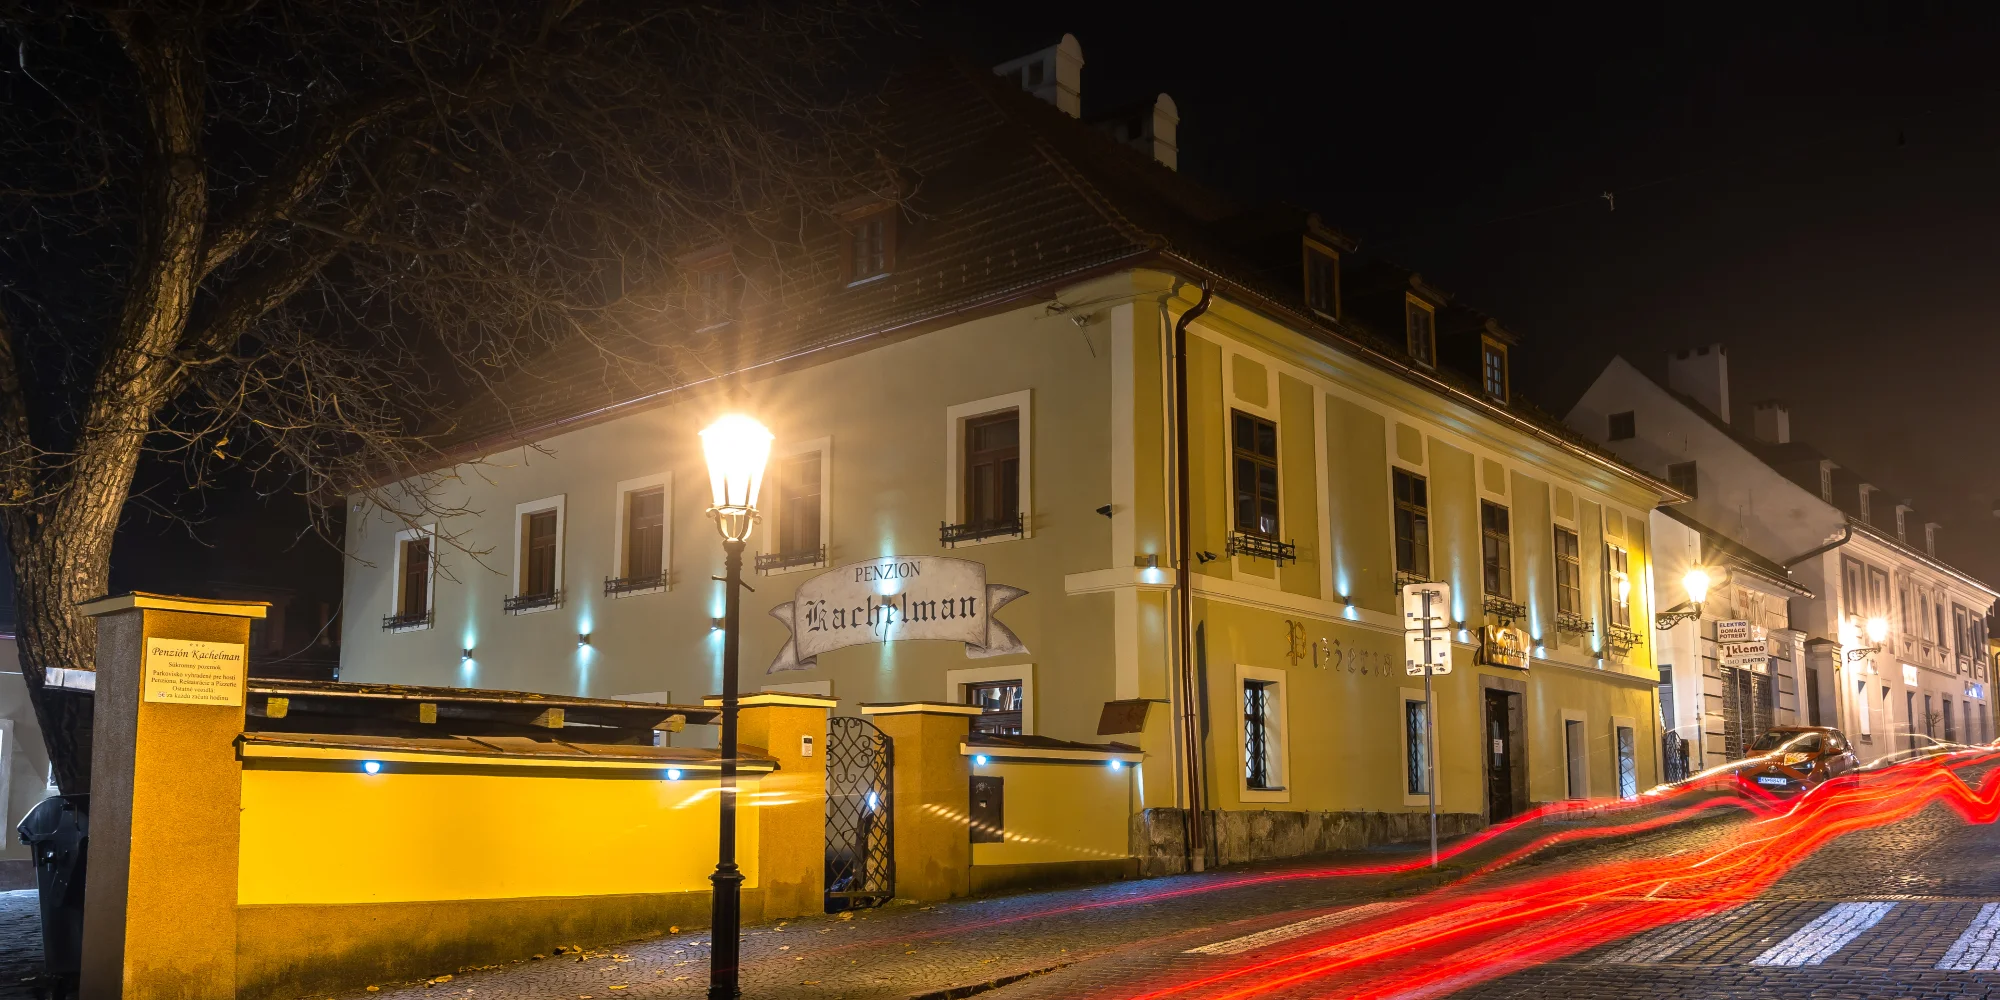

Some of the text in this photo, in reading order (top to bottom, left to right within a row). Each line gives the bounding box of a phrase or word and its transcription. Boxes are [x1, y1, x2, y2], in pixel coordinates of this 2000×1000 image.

[854, 561, 922, 583] PENZION
[805, 592, 977, 646] Kachelman
[151, 646, 240, 661] Penzión Kachelman
[1742, 656, 1765, 664] ELEKTRO
